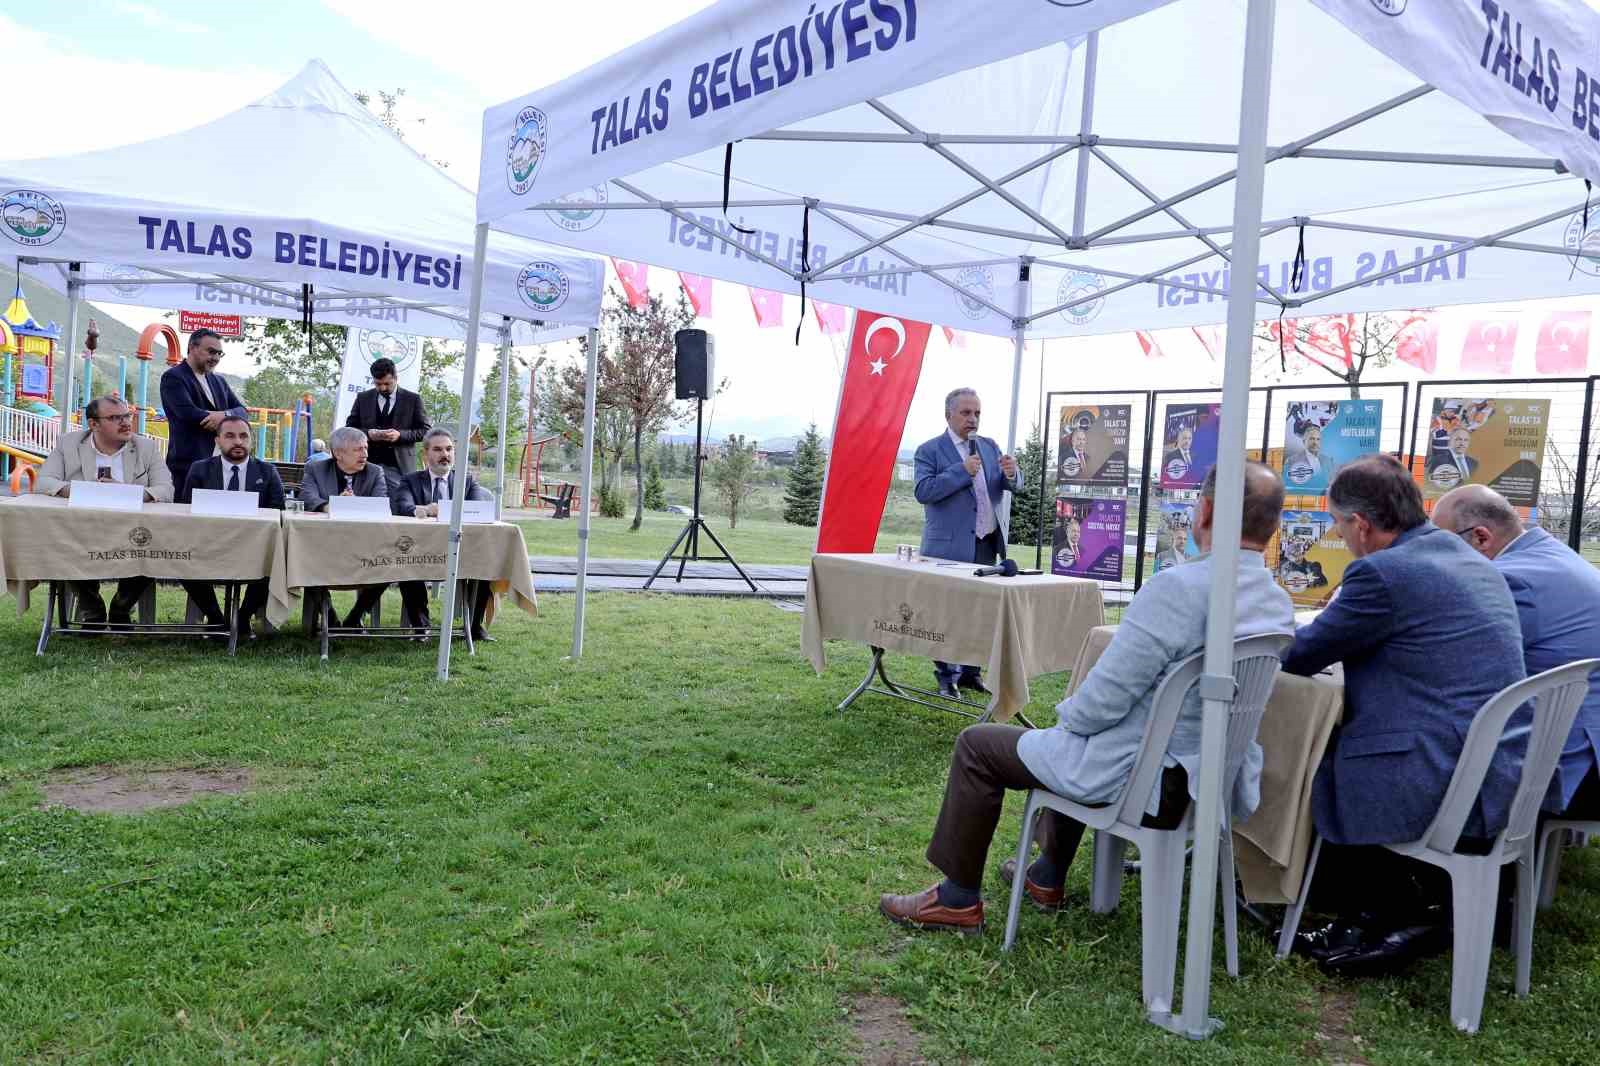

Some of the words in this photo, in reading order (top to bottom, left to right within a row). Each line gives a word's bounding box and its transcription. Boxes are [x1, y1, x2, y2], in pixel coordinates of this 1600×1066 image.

[1480, 0, 1561, 113] TALAS
[592, 79, 671, 155] TALAS
[138, 216, 253, 259] TALAS
[275, 231, 463, 290] BELEDİYESİ
[88, 551, 126, 561] TALAS
